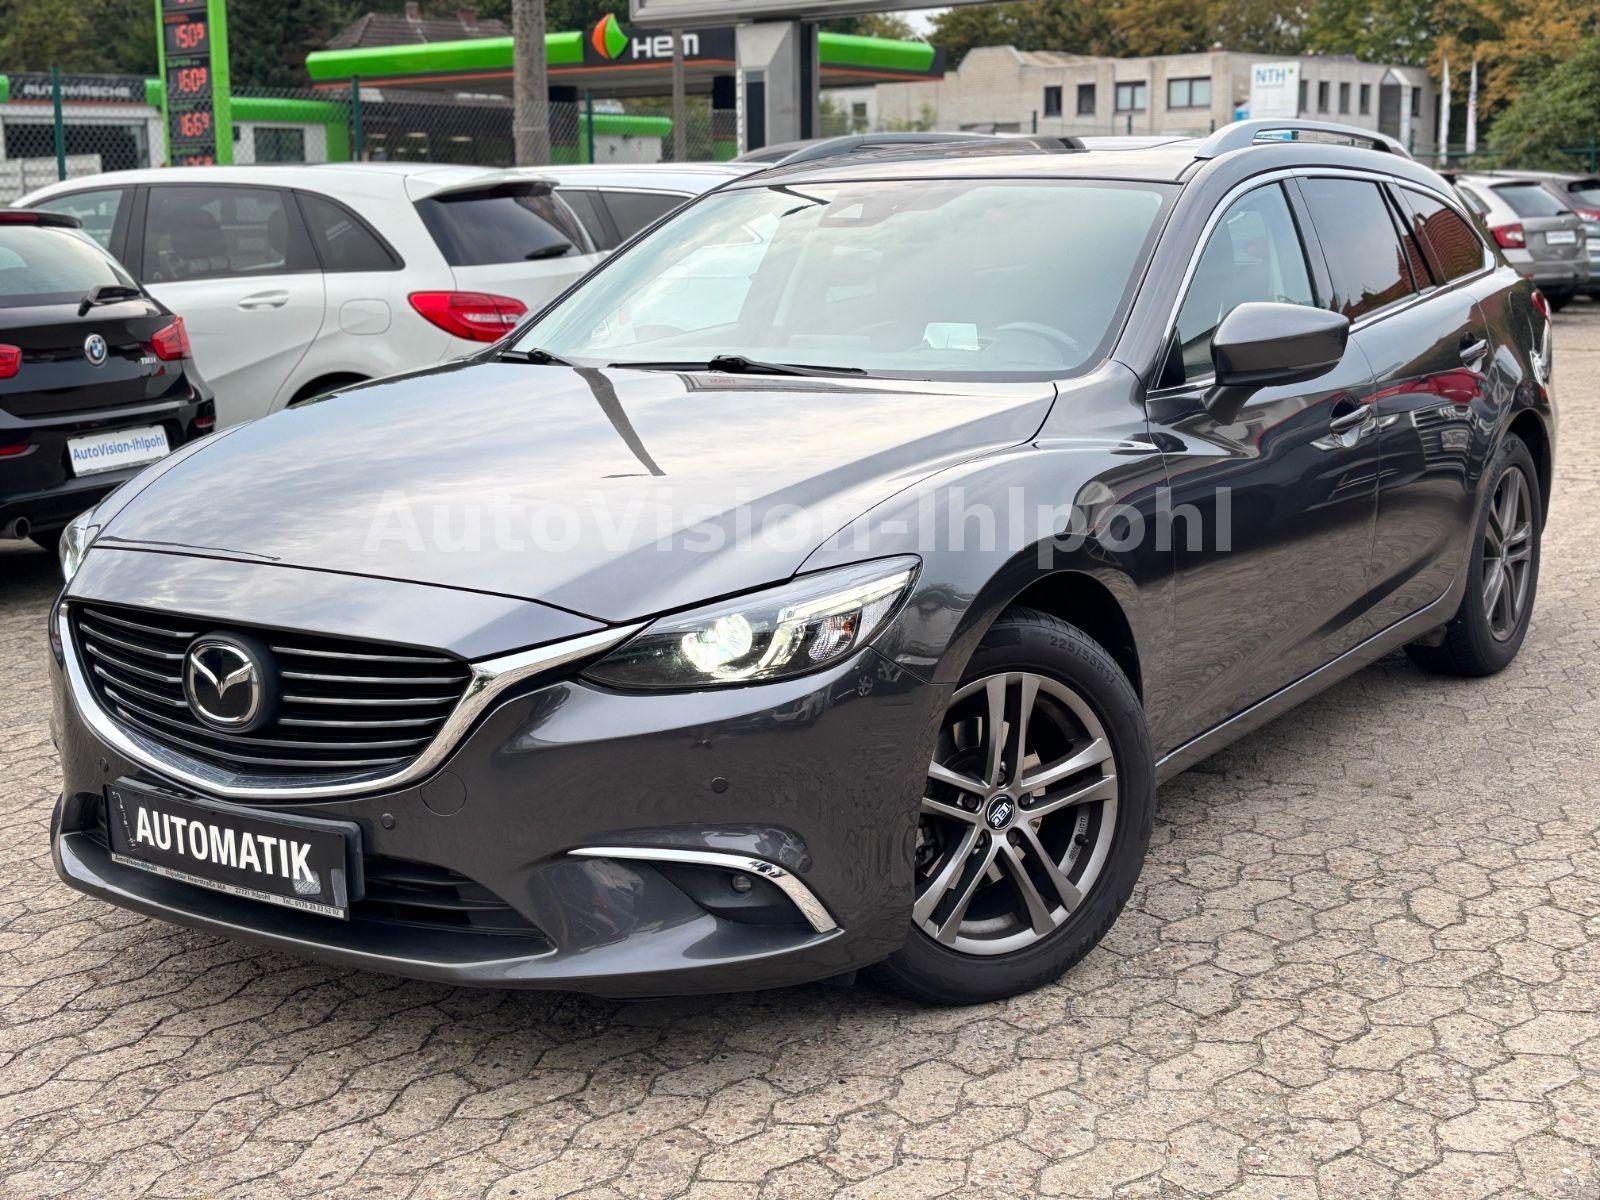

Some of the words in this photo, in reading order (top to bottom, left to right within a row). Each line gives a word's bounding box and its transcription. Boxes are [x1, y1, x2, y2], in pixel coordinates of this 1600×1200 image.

[1256, 68, 1286, 82] NTH
[73, 434, 166, 460] AutoVision-Ihlpohl
[136, 806, 315, 883] AUTOMATIK
